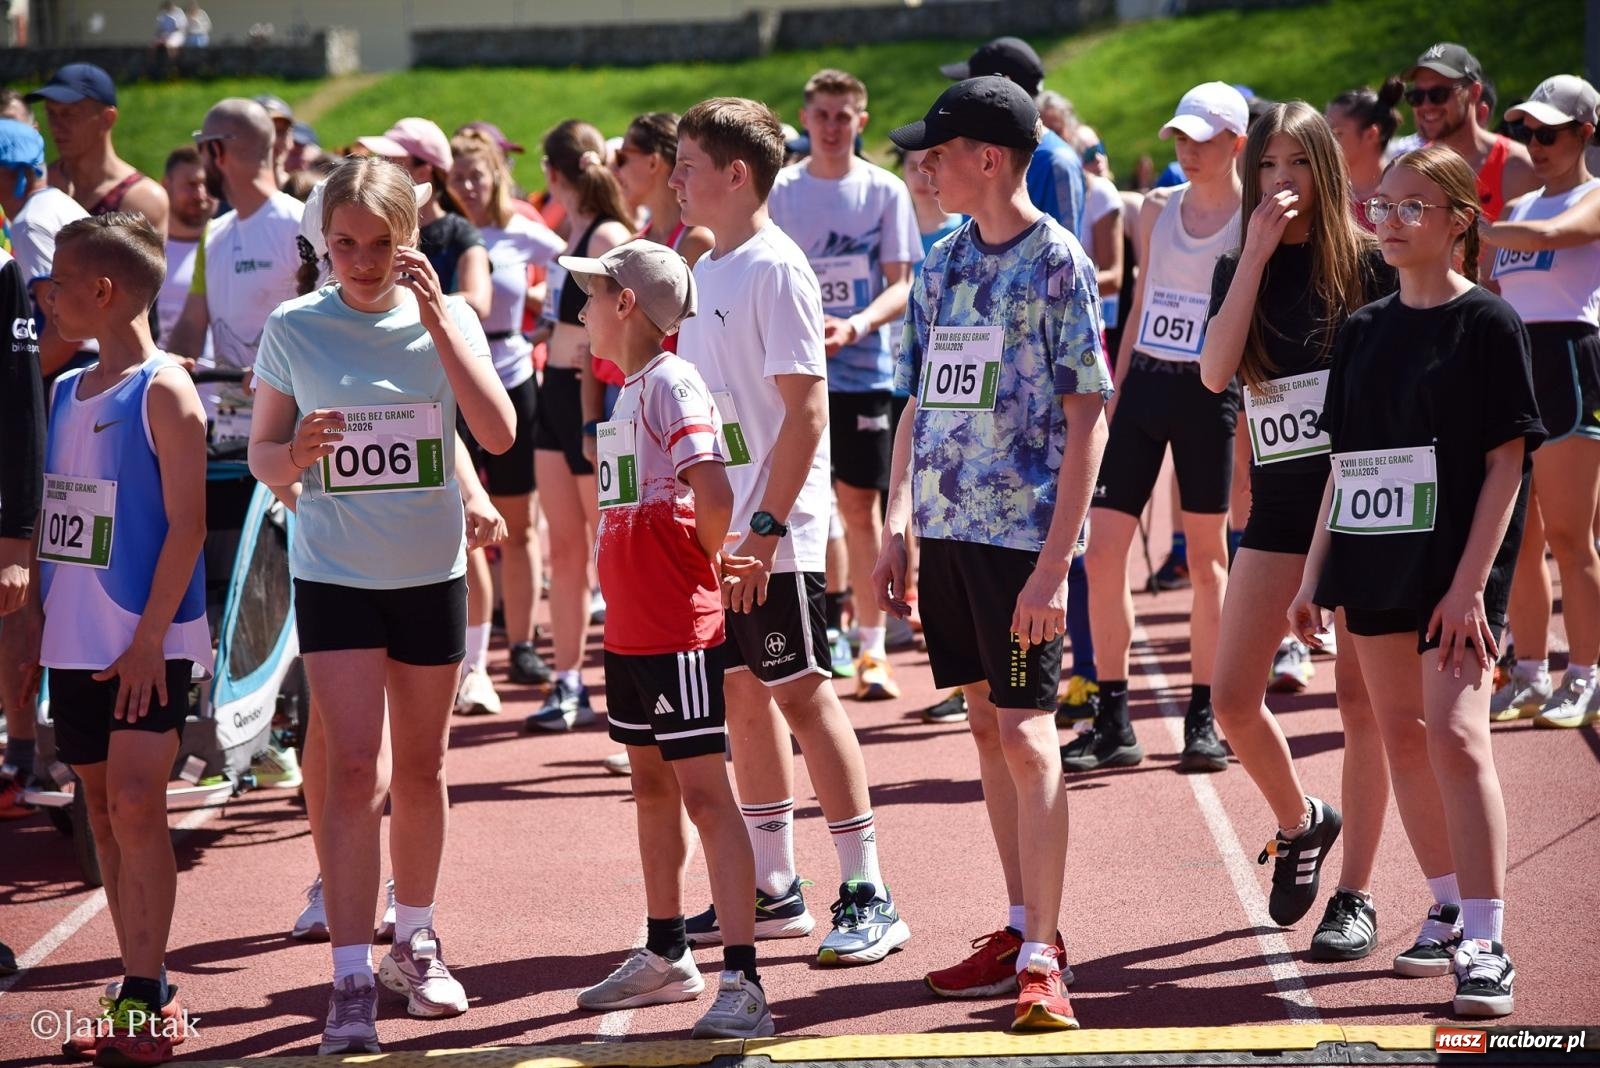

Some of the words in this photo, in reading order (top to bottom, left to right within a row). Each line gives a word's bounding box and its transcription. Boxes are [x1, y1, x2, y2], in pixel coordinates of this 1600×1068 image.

[949, 332, 961, 341] BIEG
[961, 332, 972, 341] BEZ
[971, 332, 991, 341] GRANIC
[1153, 315, 1194, 343] 051
[933, 343, 964, 351] 3MAJA2026
[936, 363, 977, 395] 015
[1278, 383, 1292, 392] BEZ
[1292, 377, 1320, 390] GRANIC
[347, 412, 366, 422] BIEG
[368, 411, 382, 421] BEZ
[384, 410, 415, 420] GRANIC
[1260, 409, 1321, 446] 003
[335, 442, 411, 477] 006
[1340, 458, 1357, 468] XVIII
[1358, 457, 1374, 467] BIEG
[1375, 456, 1387, 466] BEZ
[1388, 454, 1414, 465] GRANIC
[1341, 467, 1379, 478] 3MAJA2026
[74, 482, 98, 493] GRANIC
[1351, 487, 1404, 520] 001
[49, 513, 83, 548] 012
[1010, 650, 1018, 687] PASSION
